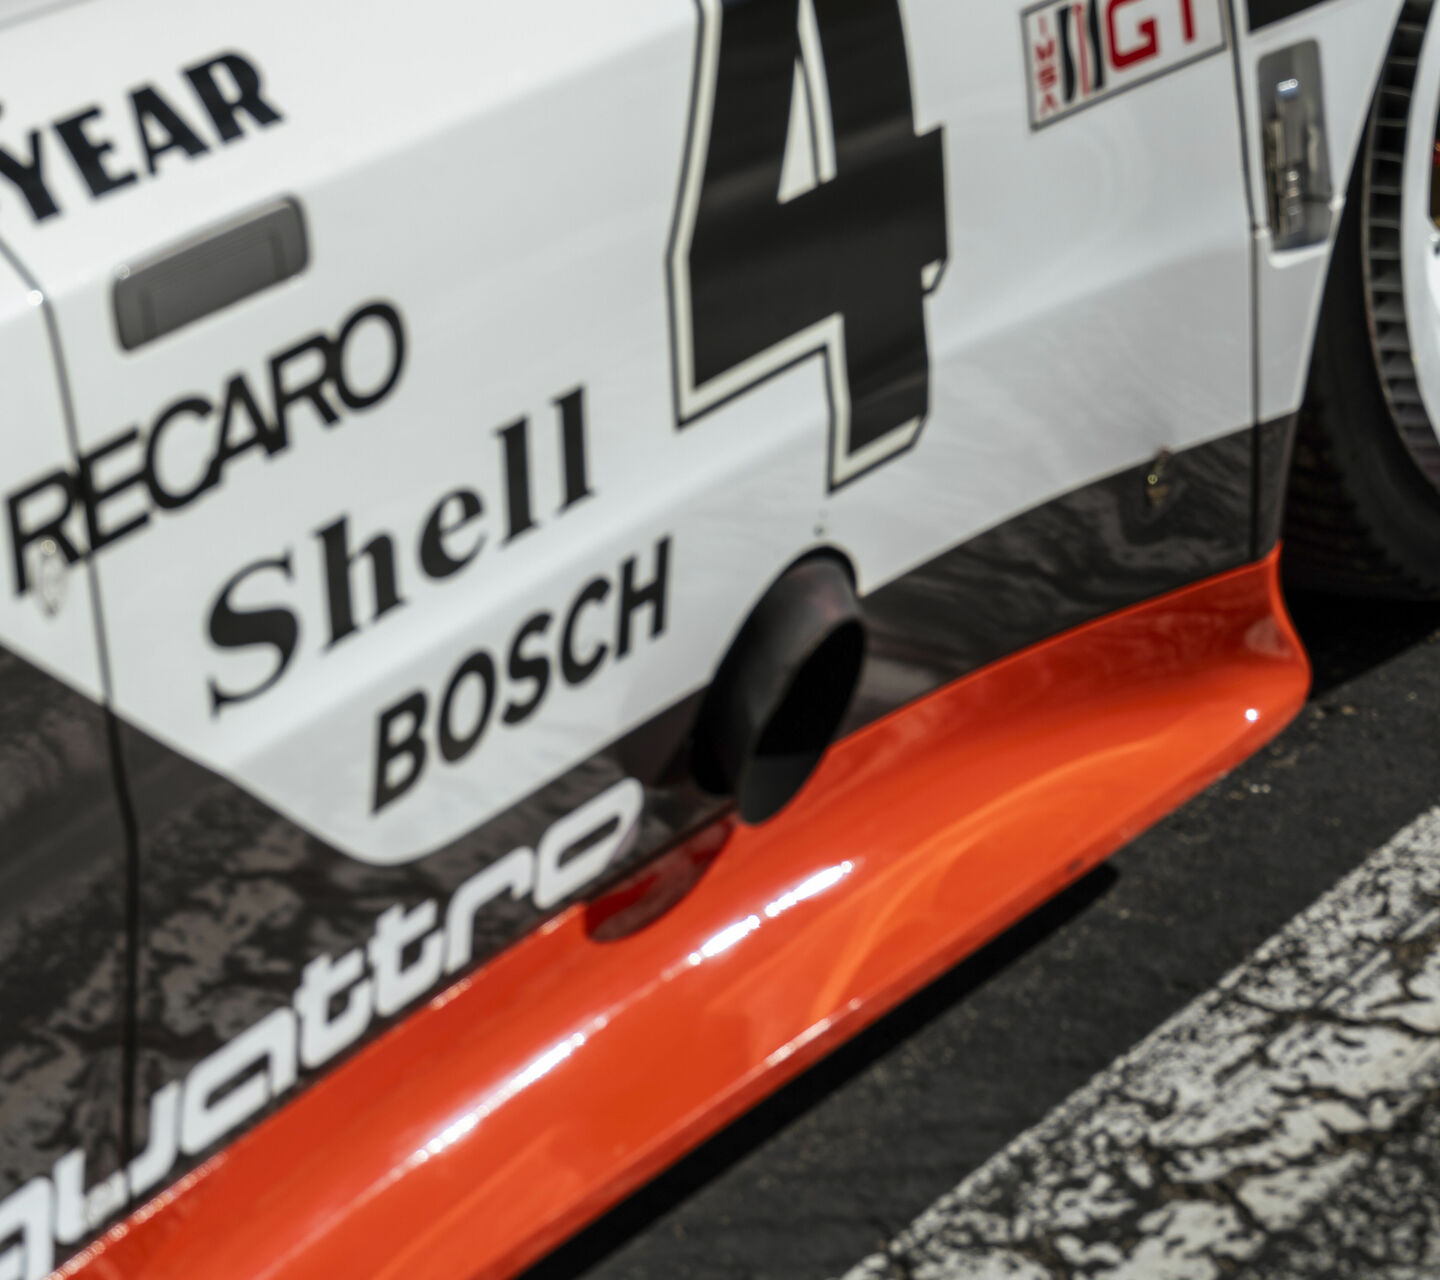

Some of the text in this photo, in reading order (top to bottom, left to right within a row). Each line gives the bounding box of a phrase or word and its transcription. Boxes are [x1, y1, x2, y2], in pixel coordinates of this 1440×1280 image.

[5, 301, 408, 598] RECARO
[207, 386, 597, 721] Shell
[370, 536, 673, 817] BOSCH
